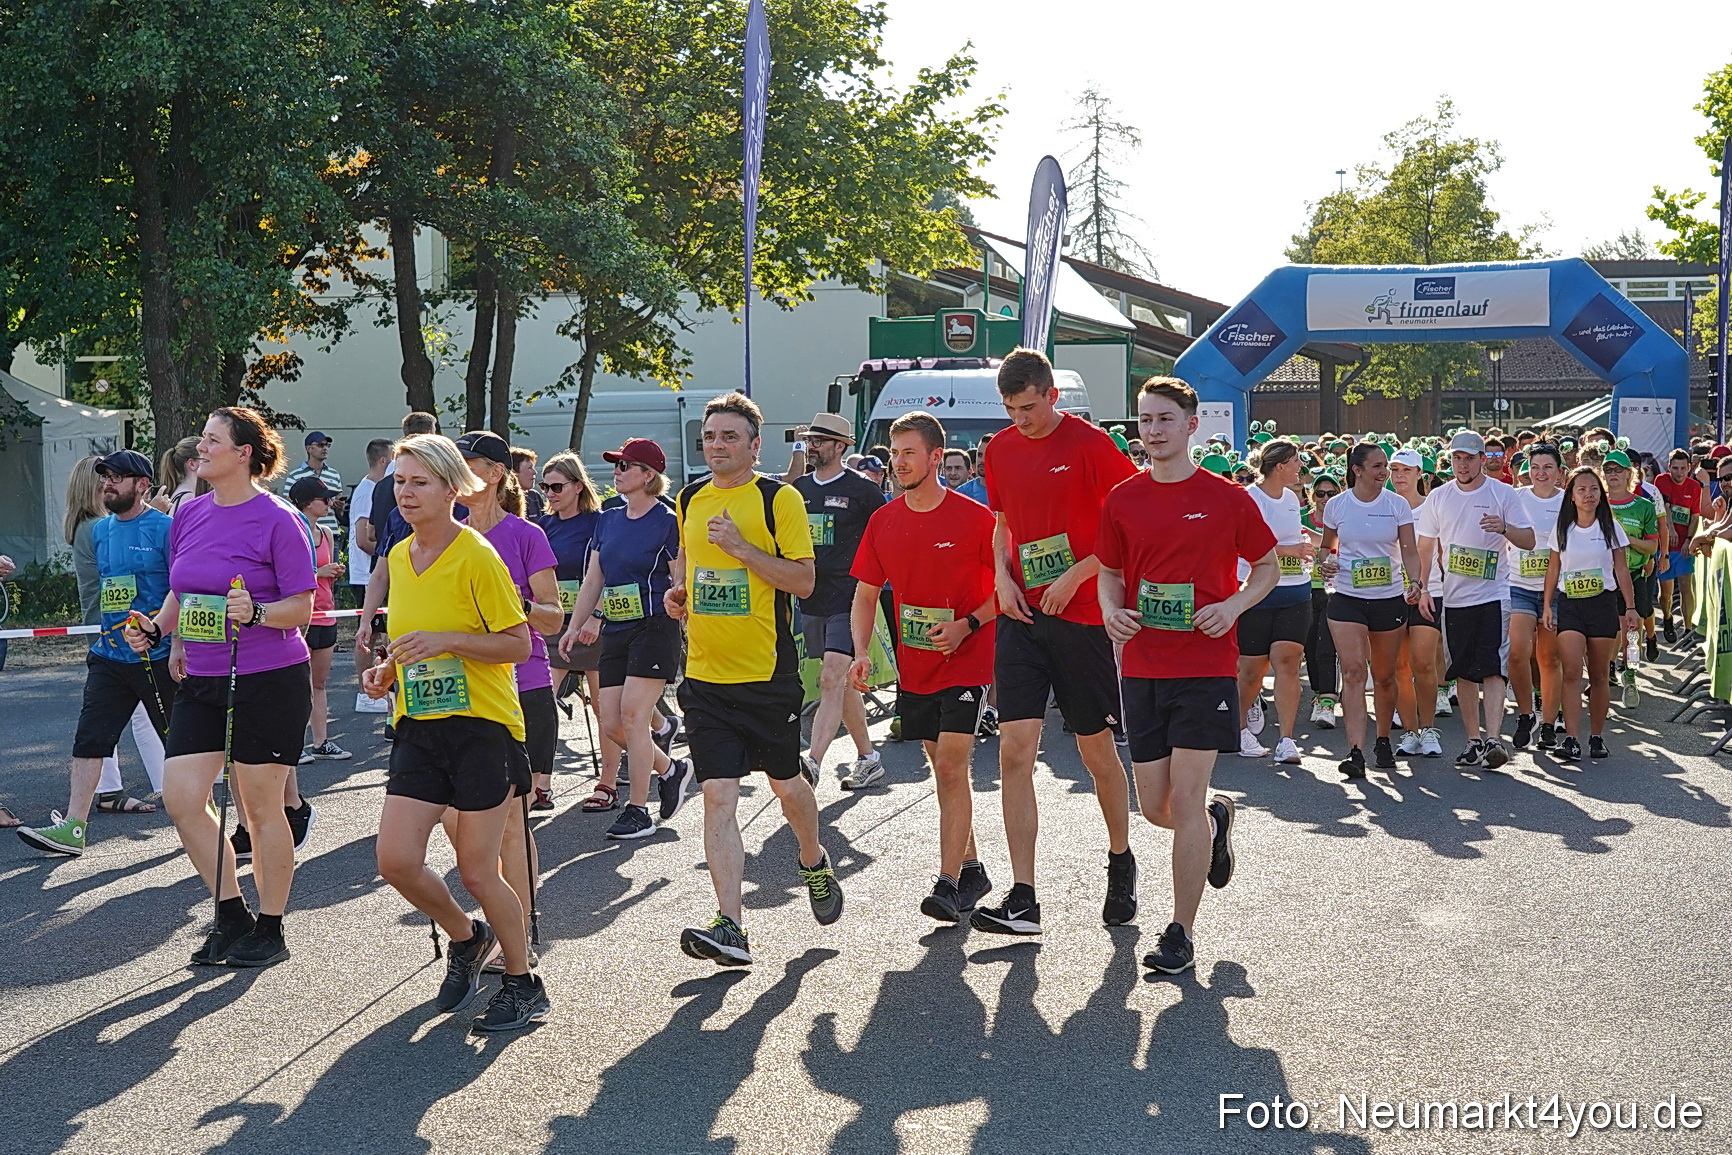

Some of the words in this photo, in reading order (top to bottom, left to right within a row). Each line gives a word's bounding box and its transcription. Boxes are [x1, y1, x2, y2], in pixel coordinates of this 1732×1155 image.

[1422, 284, 1453, 293] Fischer
[1400, 299, 1490, 318] firmenlauf
[1592, 325, 1606, 333] das
[1616, 330, 1632, 338] mit!
[1227, 331, 1276, 342] Fischer
[884, 396, 924, 407] abavent
[1028, 551, 1064, 573] 1701
[1063, 551, 1074, 566] 022
[1280, 556, 1301, 567] 1893
[1453, 555, 1479, 568] 1896
[1525, 558, 1550, 569] 1879
[1023, 564, 1031, 581] RUN
[1047, 567, 1065, 575] Tobias
[1358, 567, 1386, 579] 1878
[1571, 578, 1598, 590] 1876
[104, 588, 130, 602] 1923
[700, 583, 737, 602] 1241
[740, 587, 748, 609] 2022
[609, 597, 630, 611] 958
[700, 600, 721, 608] Hausner
[1143, 597, 1184, 616] 1764
[186, 609, 216, 627] 1888
[200, 627, 214, 635] Tanja
[910, 634, 924, 642] Kirsch
[413, 676, 457, 699] 1292
[457, 678, 467, 704] 2022
[418, 698, 436, 707] Neger
[437, 696, 452, 704] Rosi
